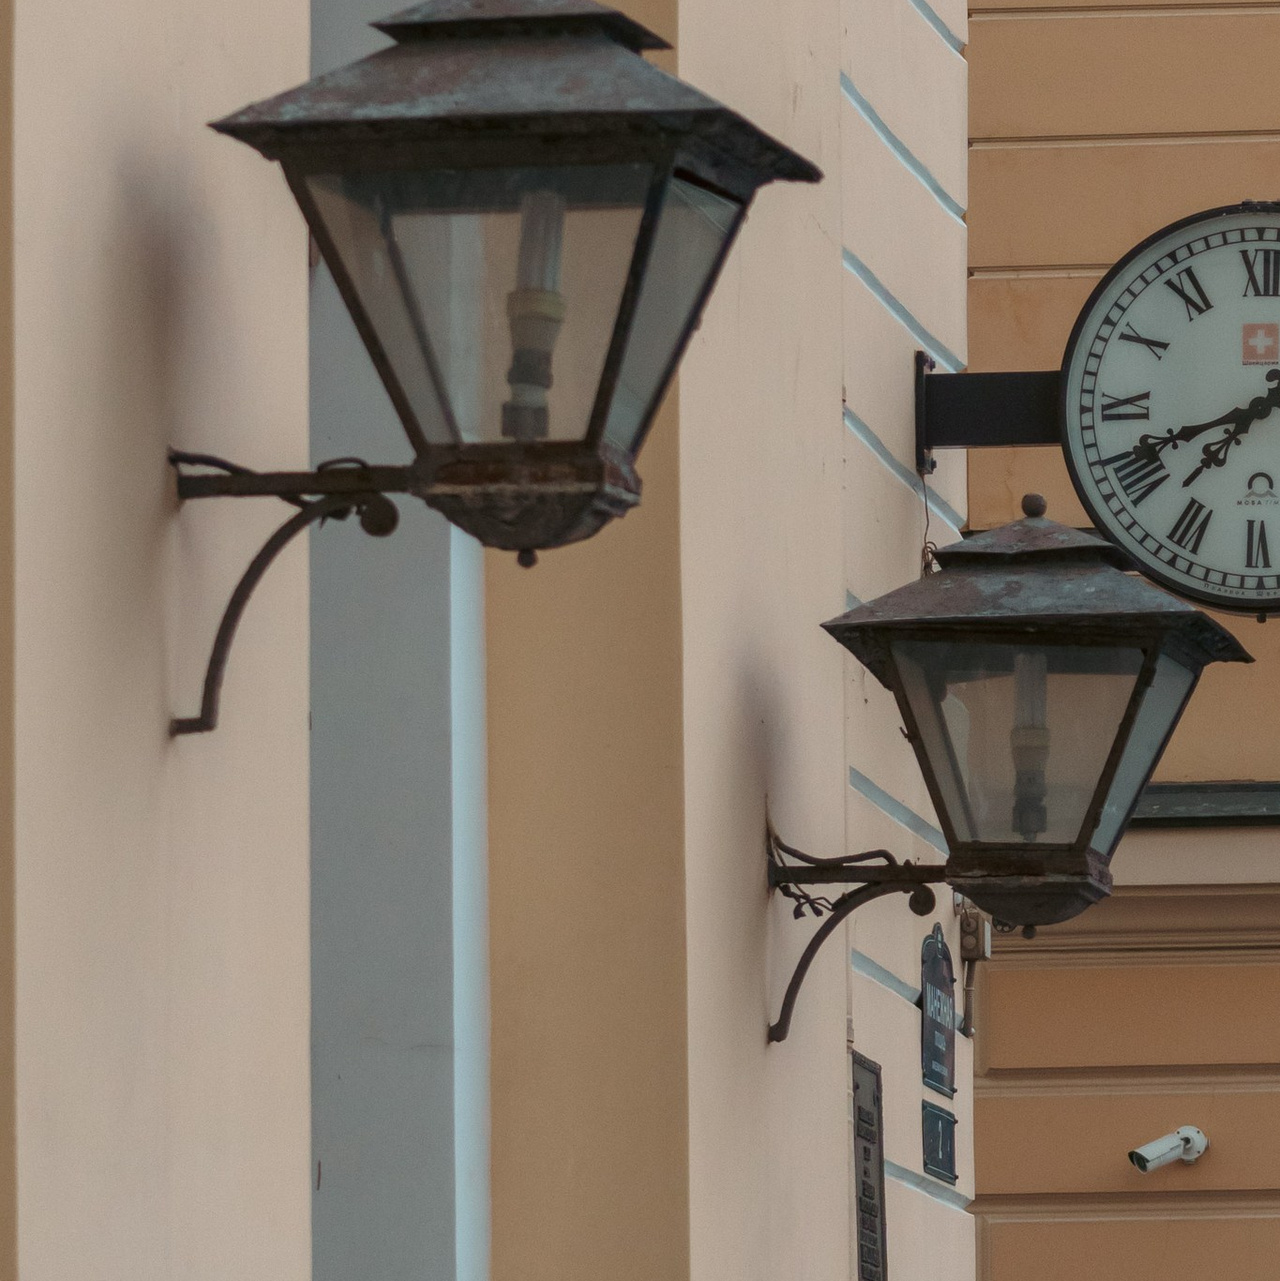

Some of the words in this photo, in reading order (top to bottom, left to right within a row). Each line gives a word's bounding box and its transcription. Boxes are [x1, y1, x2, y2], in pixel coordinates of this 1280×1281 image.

[1164, 266, 1214, 322] XI
[1118, 322, 1170, 361] X
[1101, 390, 1151, 422] IX
[1166, 497, 1213, 555] VII
[1246, 520, 1272, 568] VI
